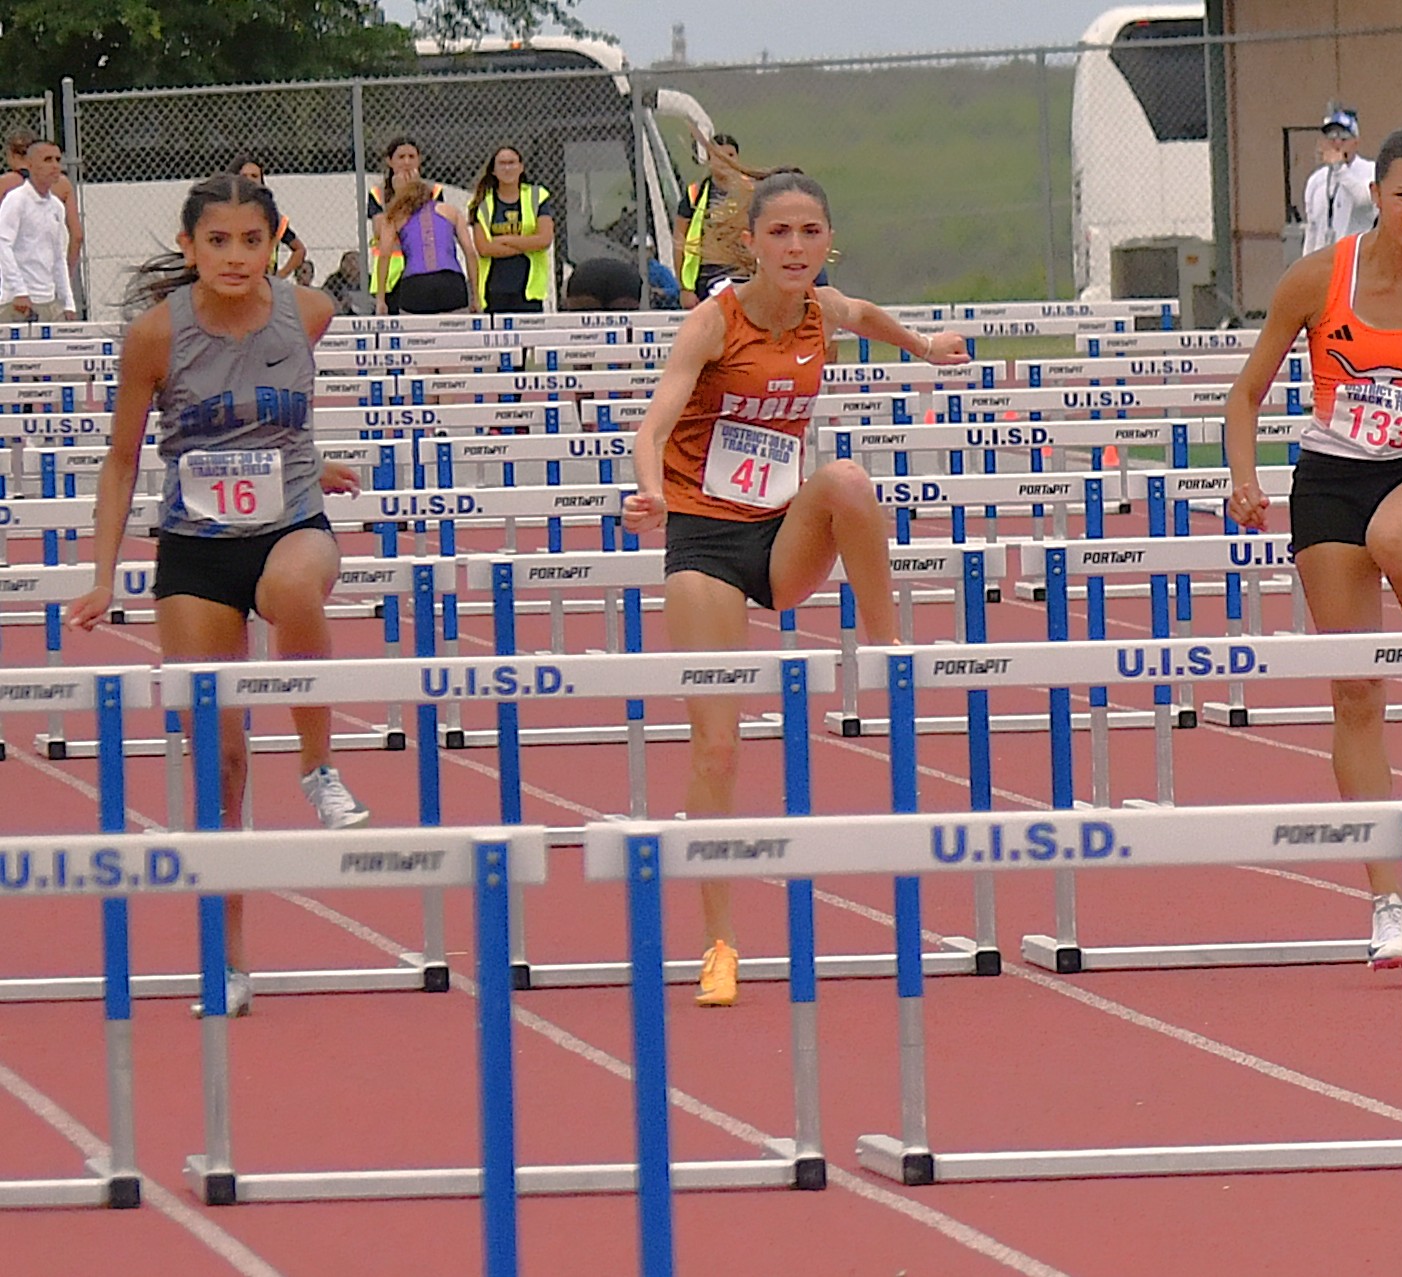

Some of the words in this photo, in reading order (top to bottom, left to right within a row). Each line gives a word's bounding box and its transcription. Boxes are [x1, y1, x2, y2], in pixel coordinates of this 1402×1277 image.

[1041, 305, 1094, 317] U.I.S.D.
[352, 319, 403, 330] U.I.S.D.
[581, 315, 633, 327] U.I.S.D.
[983, 322, 1040, 336] U.I.S.D.
[1180, 334, 1242, 348] U.I.S.D.
[355, 353, 417, 367] U.I.S.D.
[1131, 360, 1198, 375] U.I.S.D.
[514, 376, 583, 390] U.I.S.D.
[1064, 391, 1140, 408] U.I.S.D.
[1348, 392, 1382, 406] TRACK
[1386, 399, 1392, 409] &
[23, 418, 101, 434] U.I.S.D.
[365, 410, 442, 426] U.I.S.D.
[723, 425, 767, 444] DISTRICT
[967, 428, 1054, 446] U.I.S.D.
[723, 437, 757, 455] TRACK
[761, 447, 766, 457] &
[769, 448, 789, 463] FIELD
[193, 465, 227, 477] TRACK
[232, 466, 238, 475] &
[243, 464, 270, 475] FIELD
[731, 458, 771, 497] 41
[211, 480, 256, 514] 16
[381, 495, 483, 516] U.I.S.D.
[1117, 645, 1268, 678] U.I.S.D.
[421, 665, 574, 698] U.I.S.D.
[931, 821, 1132, 864] U.I.S.D.
[0, 848, 197, 891] U.I.S.D.
